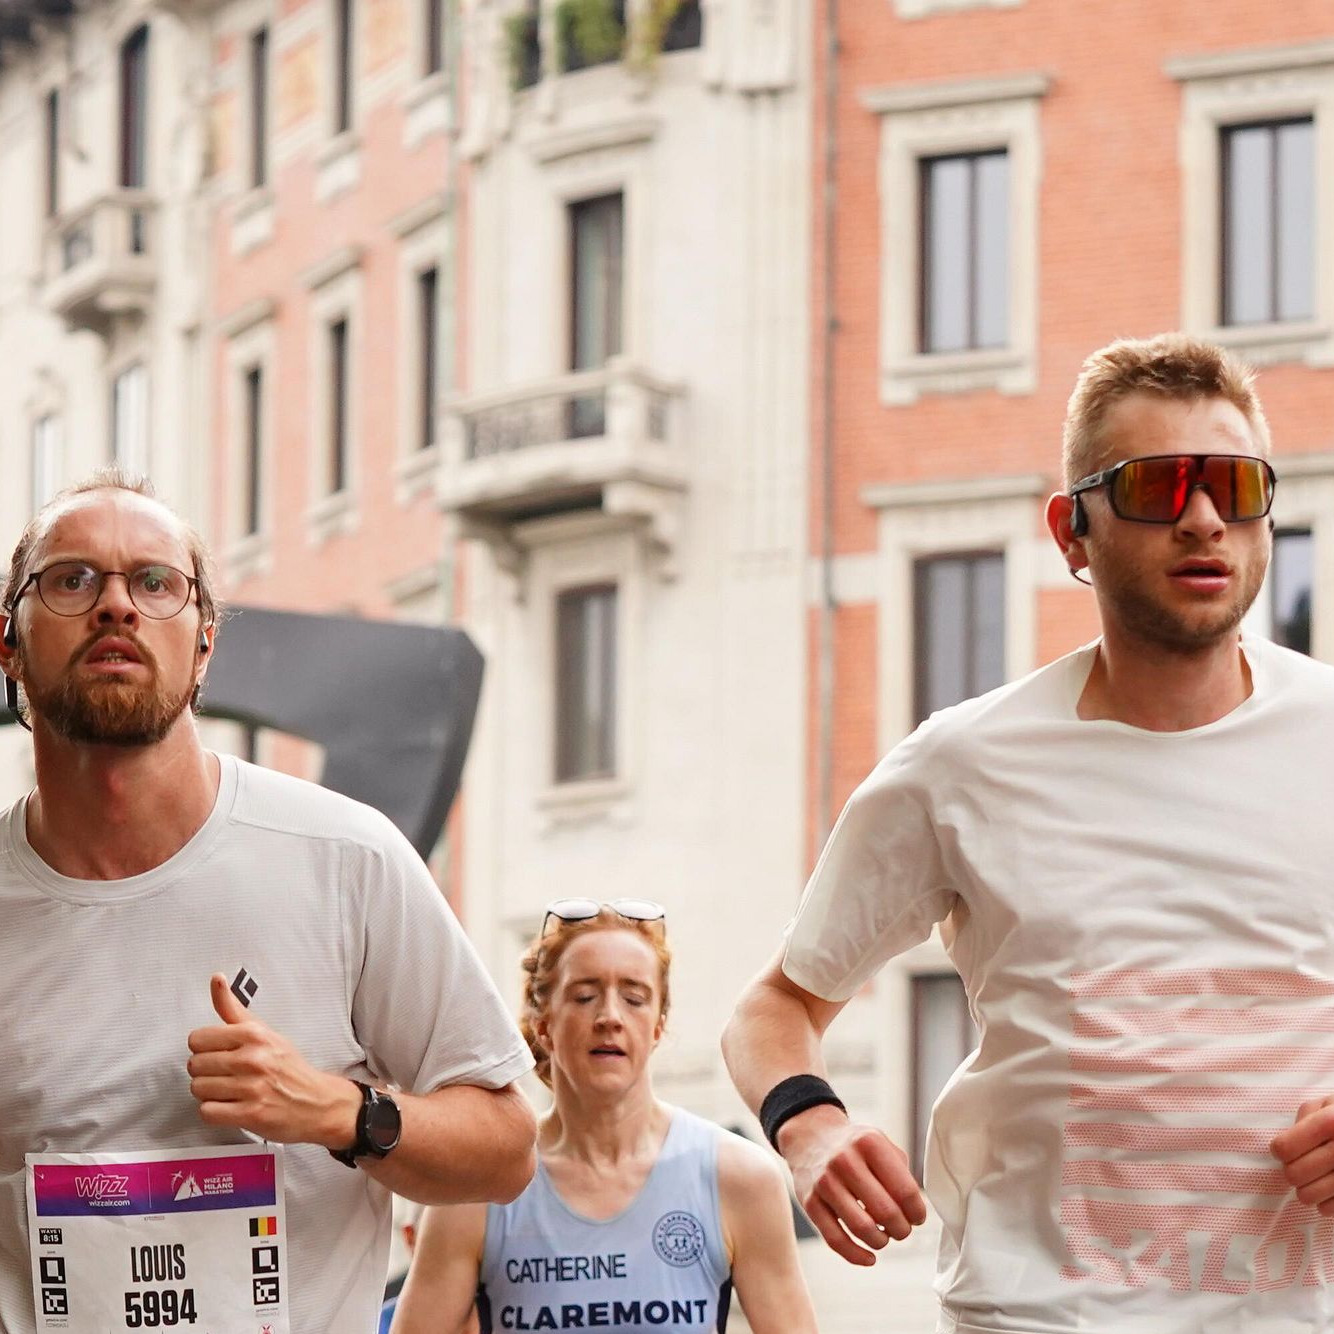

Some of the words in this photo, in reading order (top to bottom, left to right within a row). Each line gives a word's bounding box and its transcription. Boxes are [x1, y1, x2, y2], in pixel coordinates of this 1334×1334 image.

[203, 1182, 234, 1190] MILANO
[89, 1198, 130, 1207] wizzair.com
[43, 1234, 59, 1242] 8:15
[130, 1243, 186, 1283] LOUIS
[506, 1254, 627, 1284] CATHERINE
[124, 1288, 198, 1328] 5994
[500, 1300, 708, 1331] CLAREMONT
